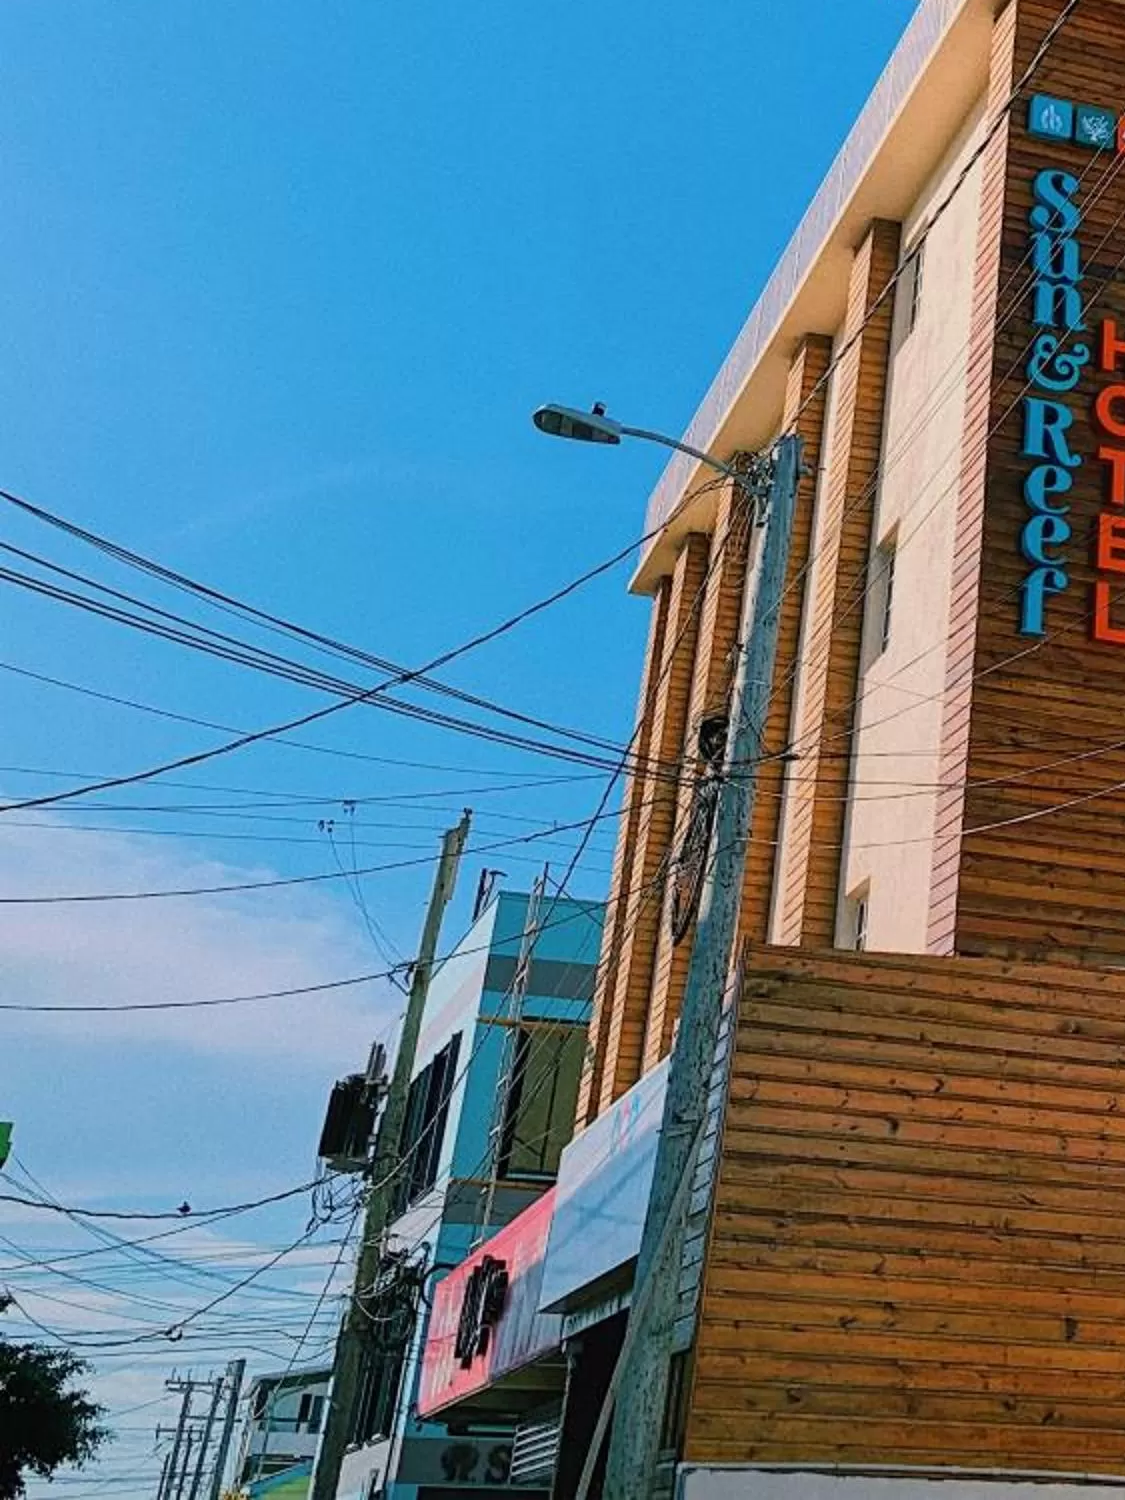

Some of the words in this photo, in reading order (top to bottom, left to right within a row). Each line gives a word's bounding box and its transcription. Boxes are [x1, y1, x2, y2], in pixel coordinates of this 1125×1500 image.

[1029, 169, 1087, 331] Sun
[1027, 335, 1089, 391] &
[1020, 396, 1082, 636] Reef
